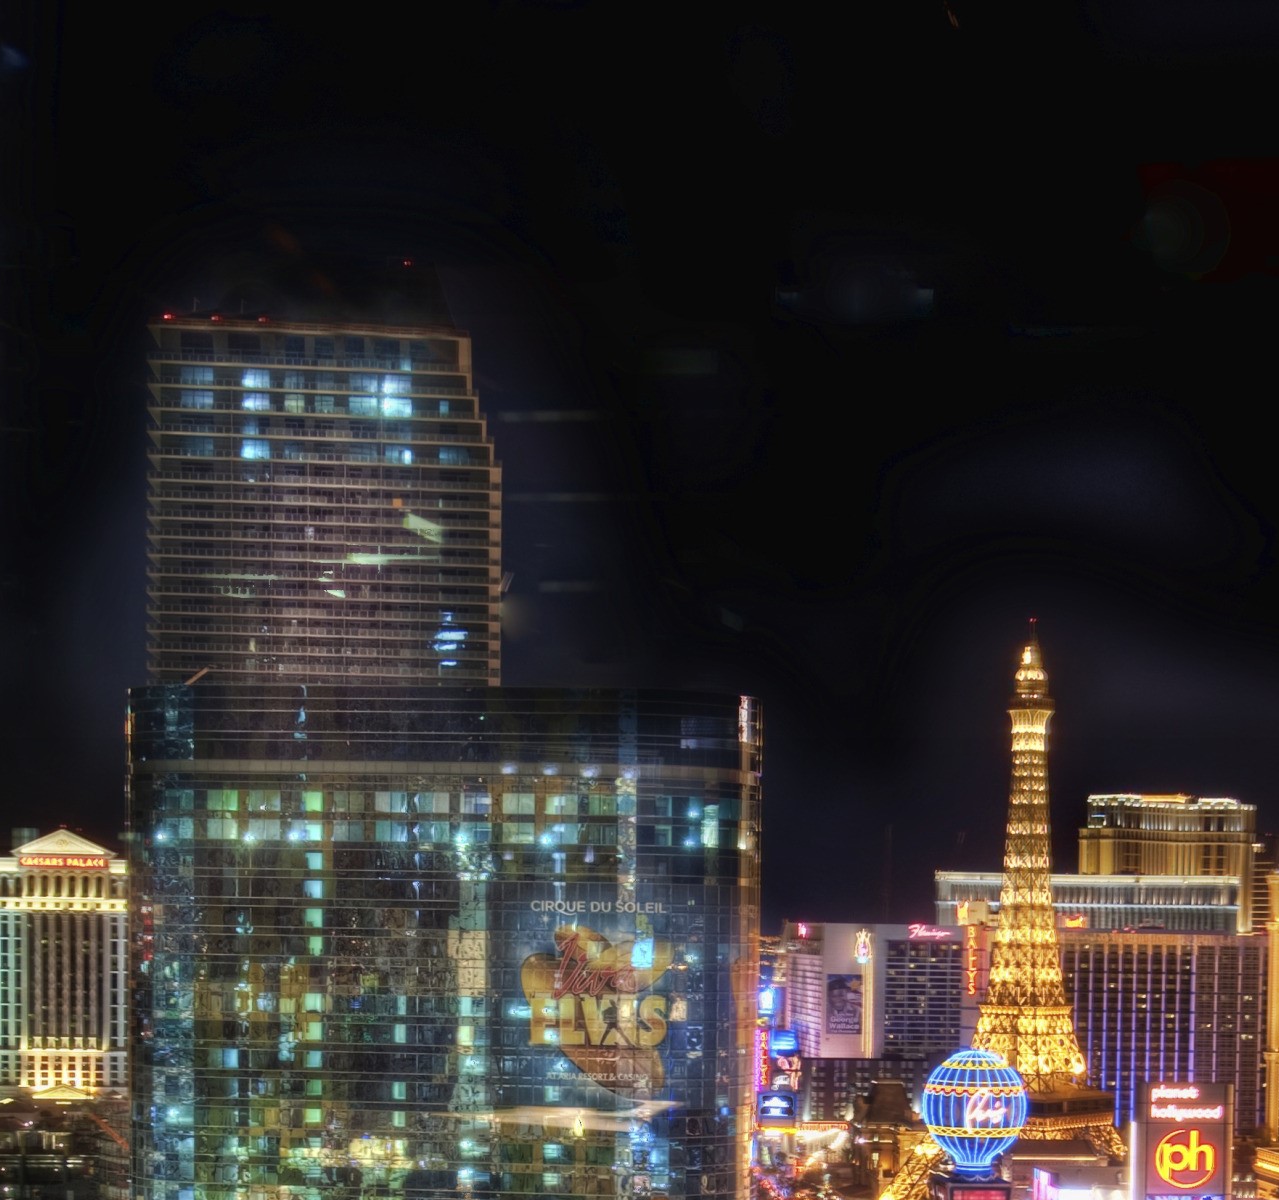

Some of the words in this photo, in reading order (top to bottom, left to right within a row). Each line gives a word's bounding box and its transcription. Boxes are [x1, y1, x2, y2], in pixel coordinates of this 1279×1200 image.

[20, 857, 63, 866] CAESARS
[530, 900, 586, 915] CIRQUE
[591, 901, 612, 913] DU
[616, 901, 667, 914] SOLEIL
[553, 933, 638, 1000] Viva
[528, 992, 668, 1047] ELVIS
[578, 1072, 607, 1081] RESORT
[1151, 1084, 1199, 1101] planet
[1151, 1104, 1222, 1121] hollywood
[1160, 1130, 1215, 1182] ph
